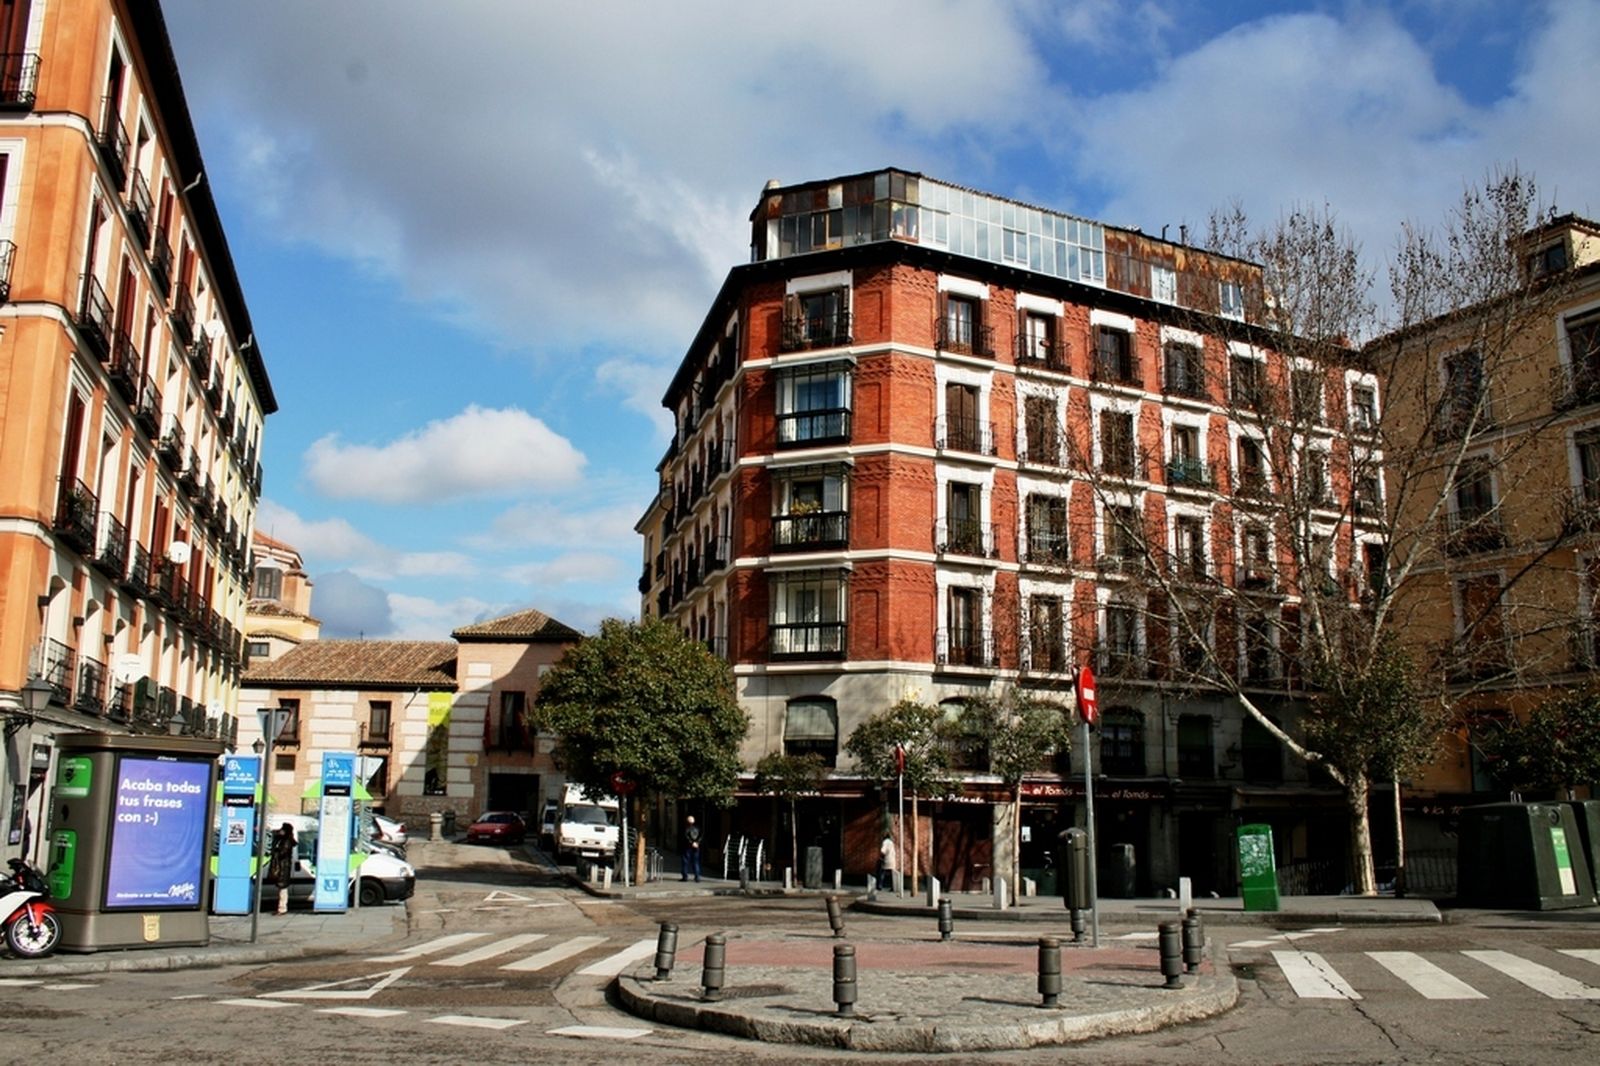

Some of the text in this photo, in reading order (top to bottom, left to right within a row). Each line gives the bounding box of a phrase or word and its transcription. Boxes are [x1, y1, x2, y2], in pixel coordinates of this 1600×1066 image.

[121, 778, 201, 794] Acaba todas
[119, 794, 183, 809] tus frases
[117, 811, 159, 826] con :-)
